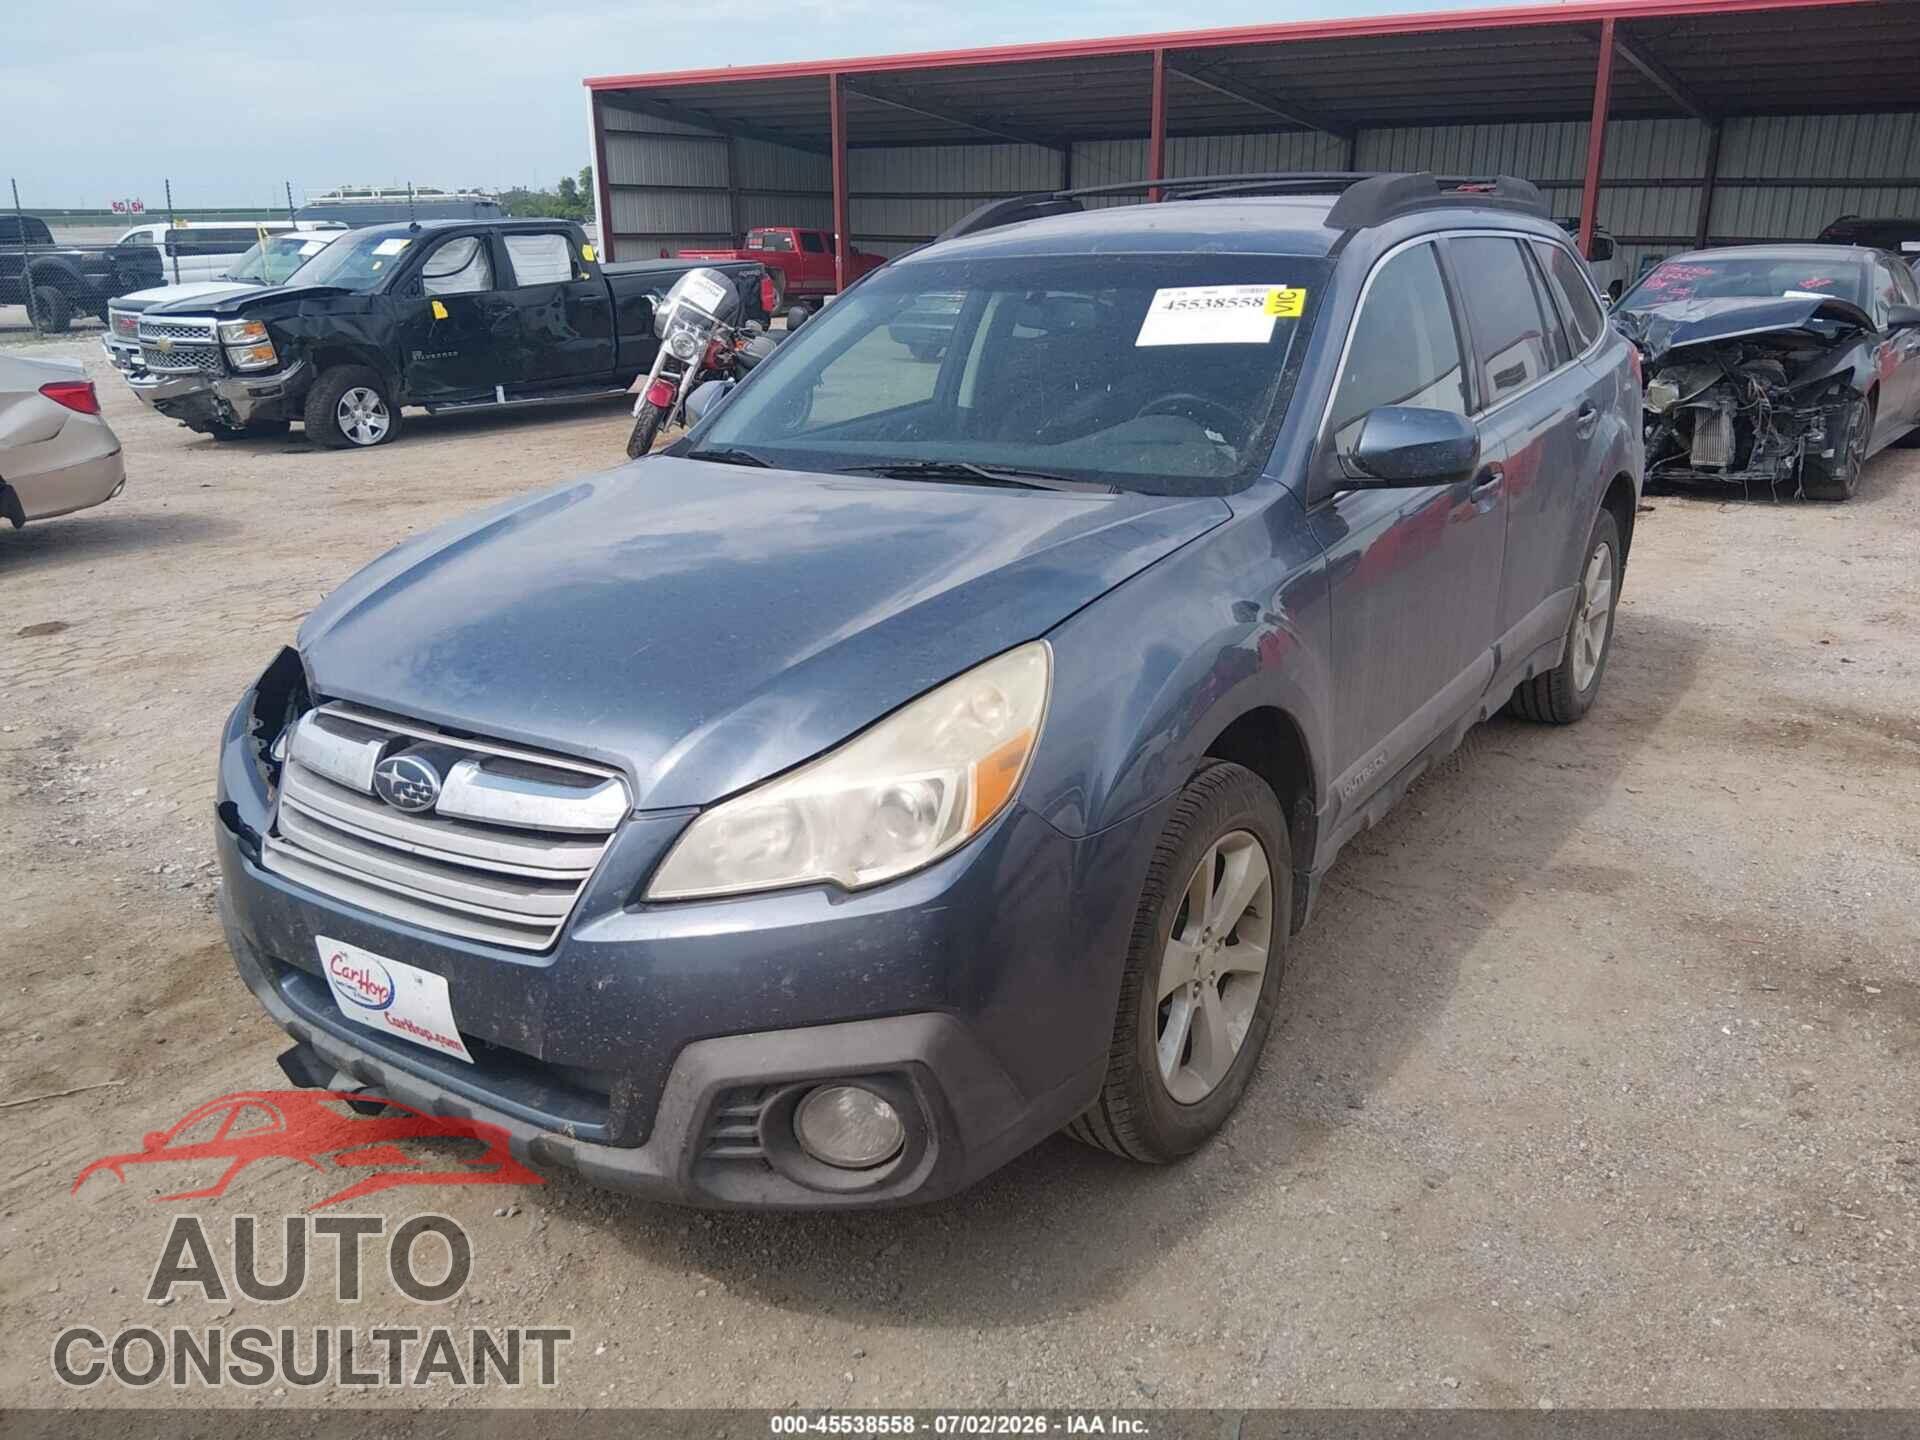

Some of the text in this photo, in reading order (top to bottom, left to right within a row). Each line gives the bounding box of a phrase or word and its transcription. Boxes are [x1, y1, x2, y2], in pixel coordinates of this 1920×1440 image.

[1162, 297, 1265, 311] 45538558
[1273, 290, 1297, 314] VIC
[330, 954, 389, 1003] CarHop
